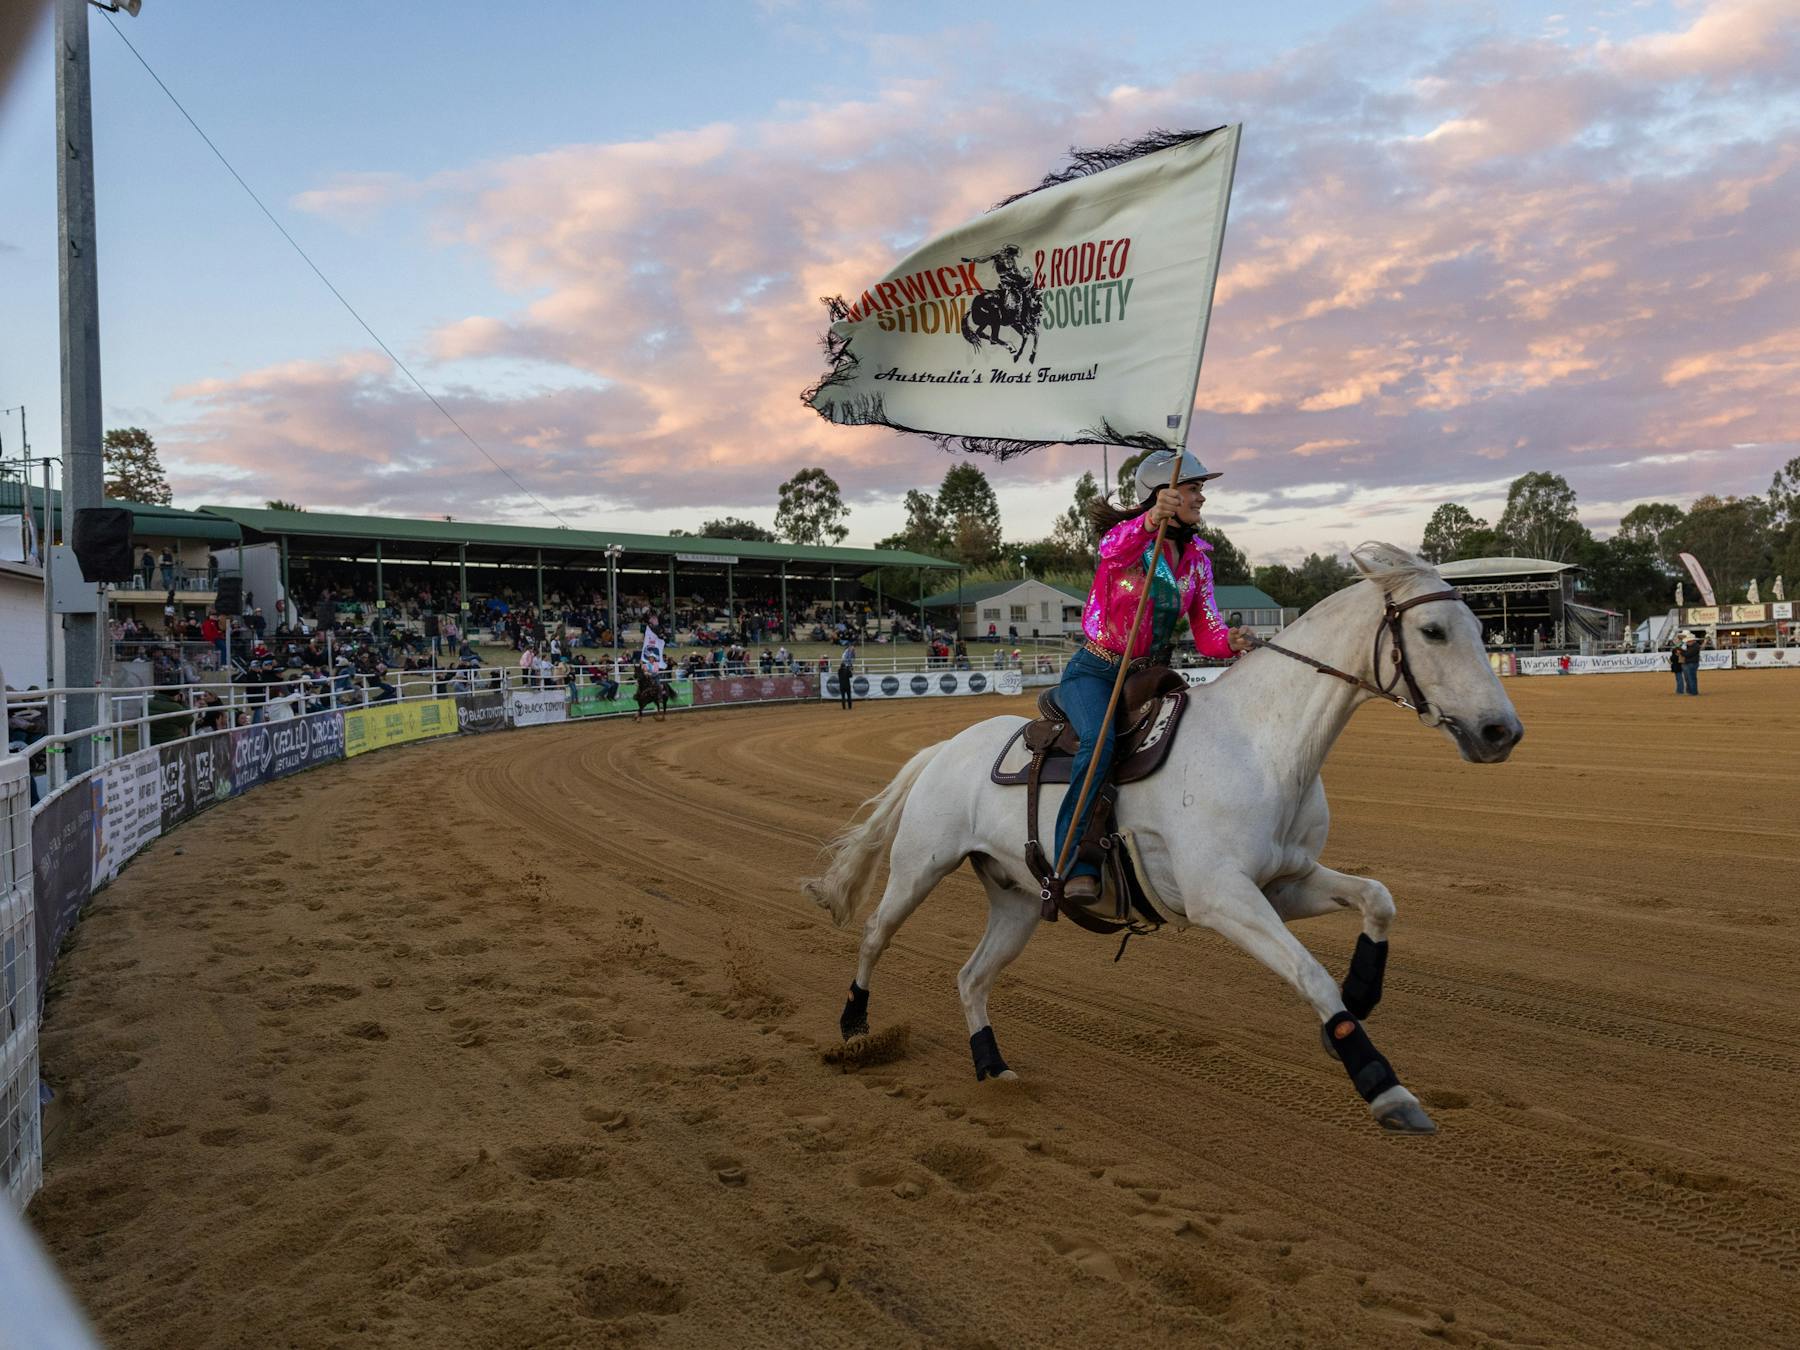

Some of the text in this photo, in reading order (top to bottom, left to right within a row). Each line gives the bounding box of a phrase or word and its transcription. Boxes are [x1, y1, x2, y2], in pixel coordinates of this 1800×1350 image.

[1033, 249, 1047, 289] &
[1050, 238, 1131, 288] RODEO
[877, 278, 1134, 335] SHOW SOCIETY
[874, 363, 1099, 384] Australia's Most Famous!
[1592, 656, 1632, 667] Warwick
[1633, 655, 1658, 667] Today
[1704, 653, 1730, 664] Today
[468, 708, 486, 722] BLACK
[525, 702, 565, 714] BLACK TOYOTA
